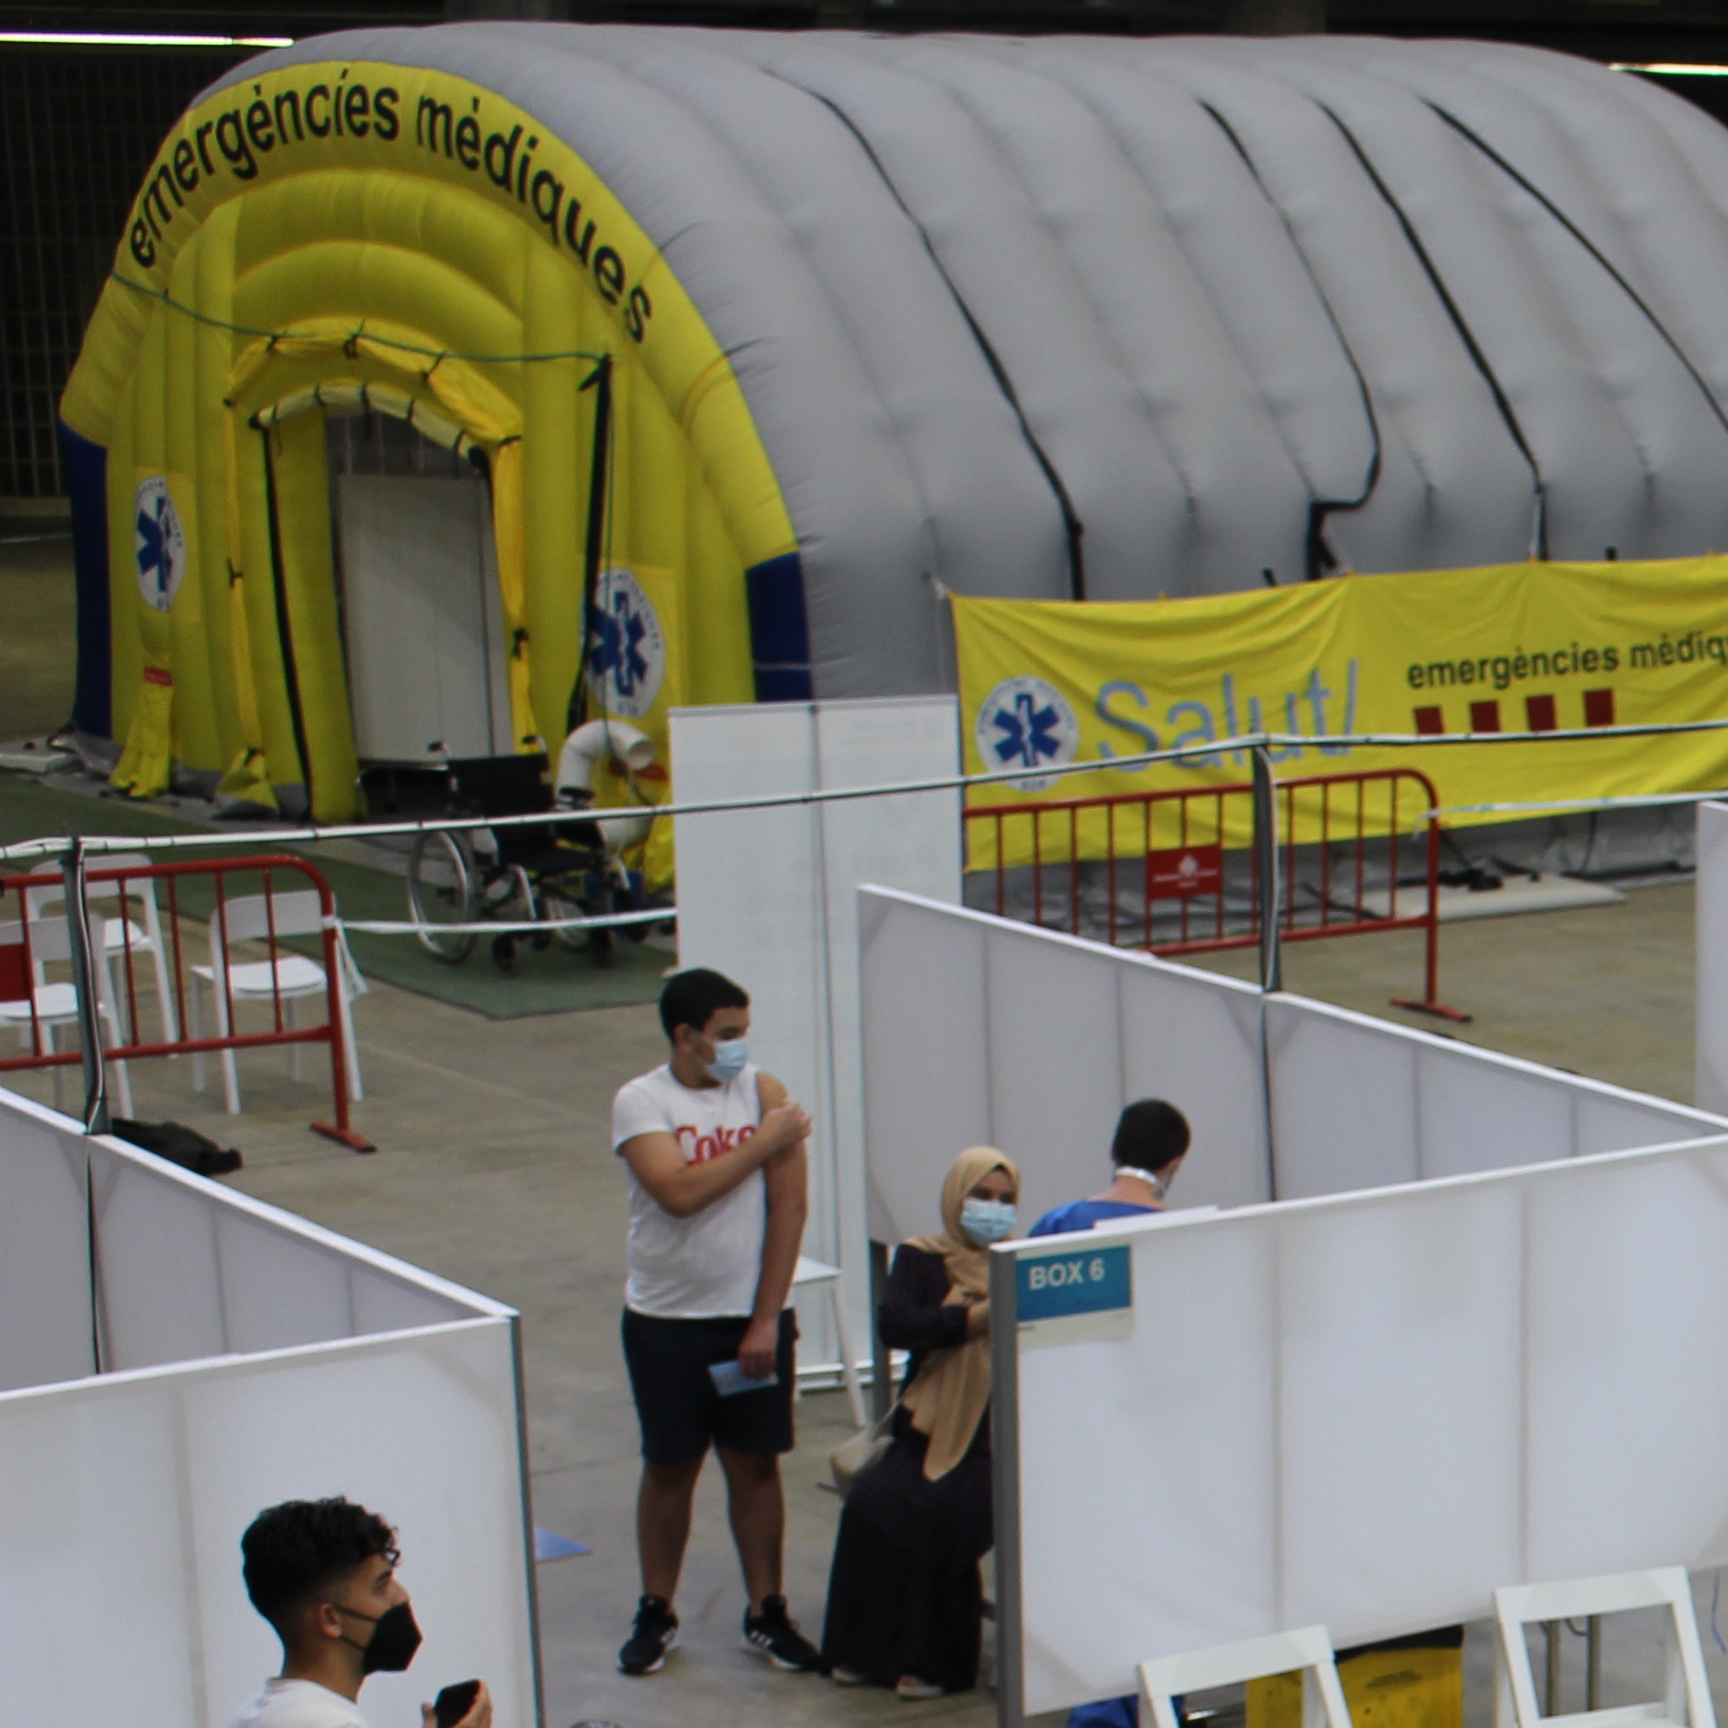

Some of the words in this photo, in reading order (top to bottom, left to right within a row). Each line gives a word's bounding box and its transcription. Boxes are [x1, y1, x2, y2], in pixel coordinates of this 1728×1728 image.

[129, 69, 400, 268] emergències
[416, 96, 653, 344] mèdiques
[1406, 640, 1620, 690] emergències
[1028, 1260, 1085, 1291] BOX
[1088, 1257, 1105, 1282] 6
